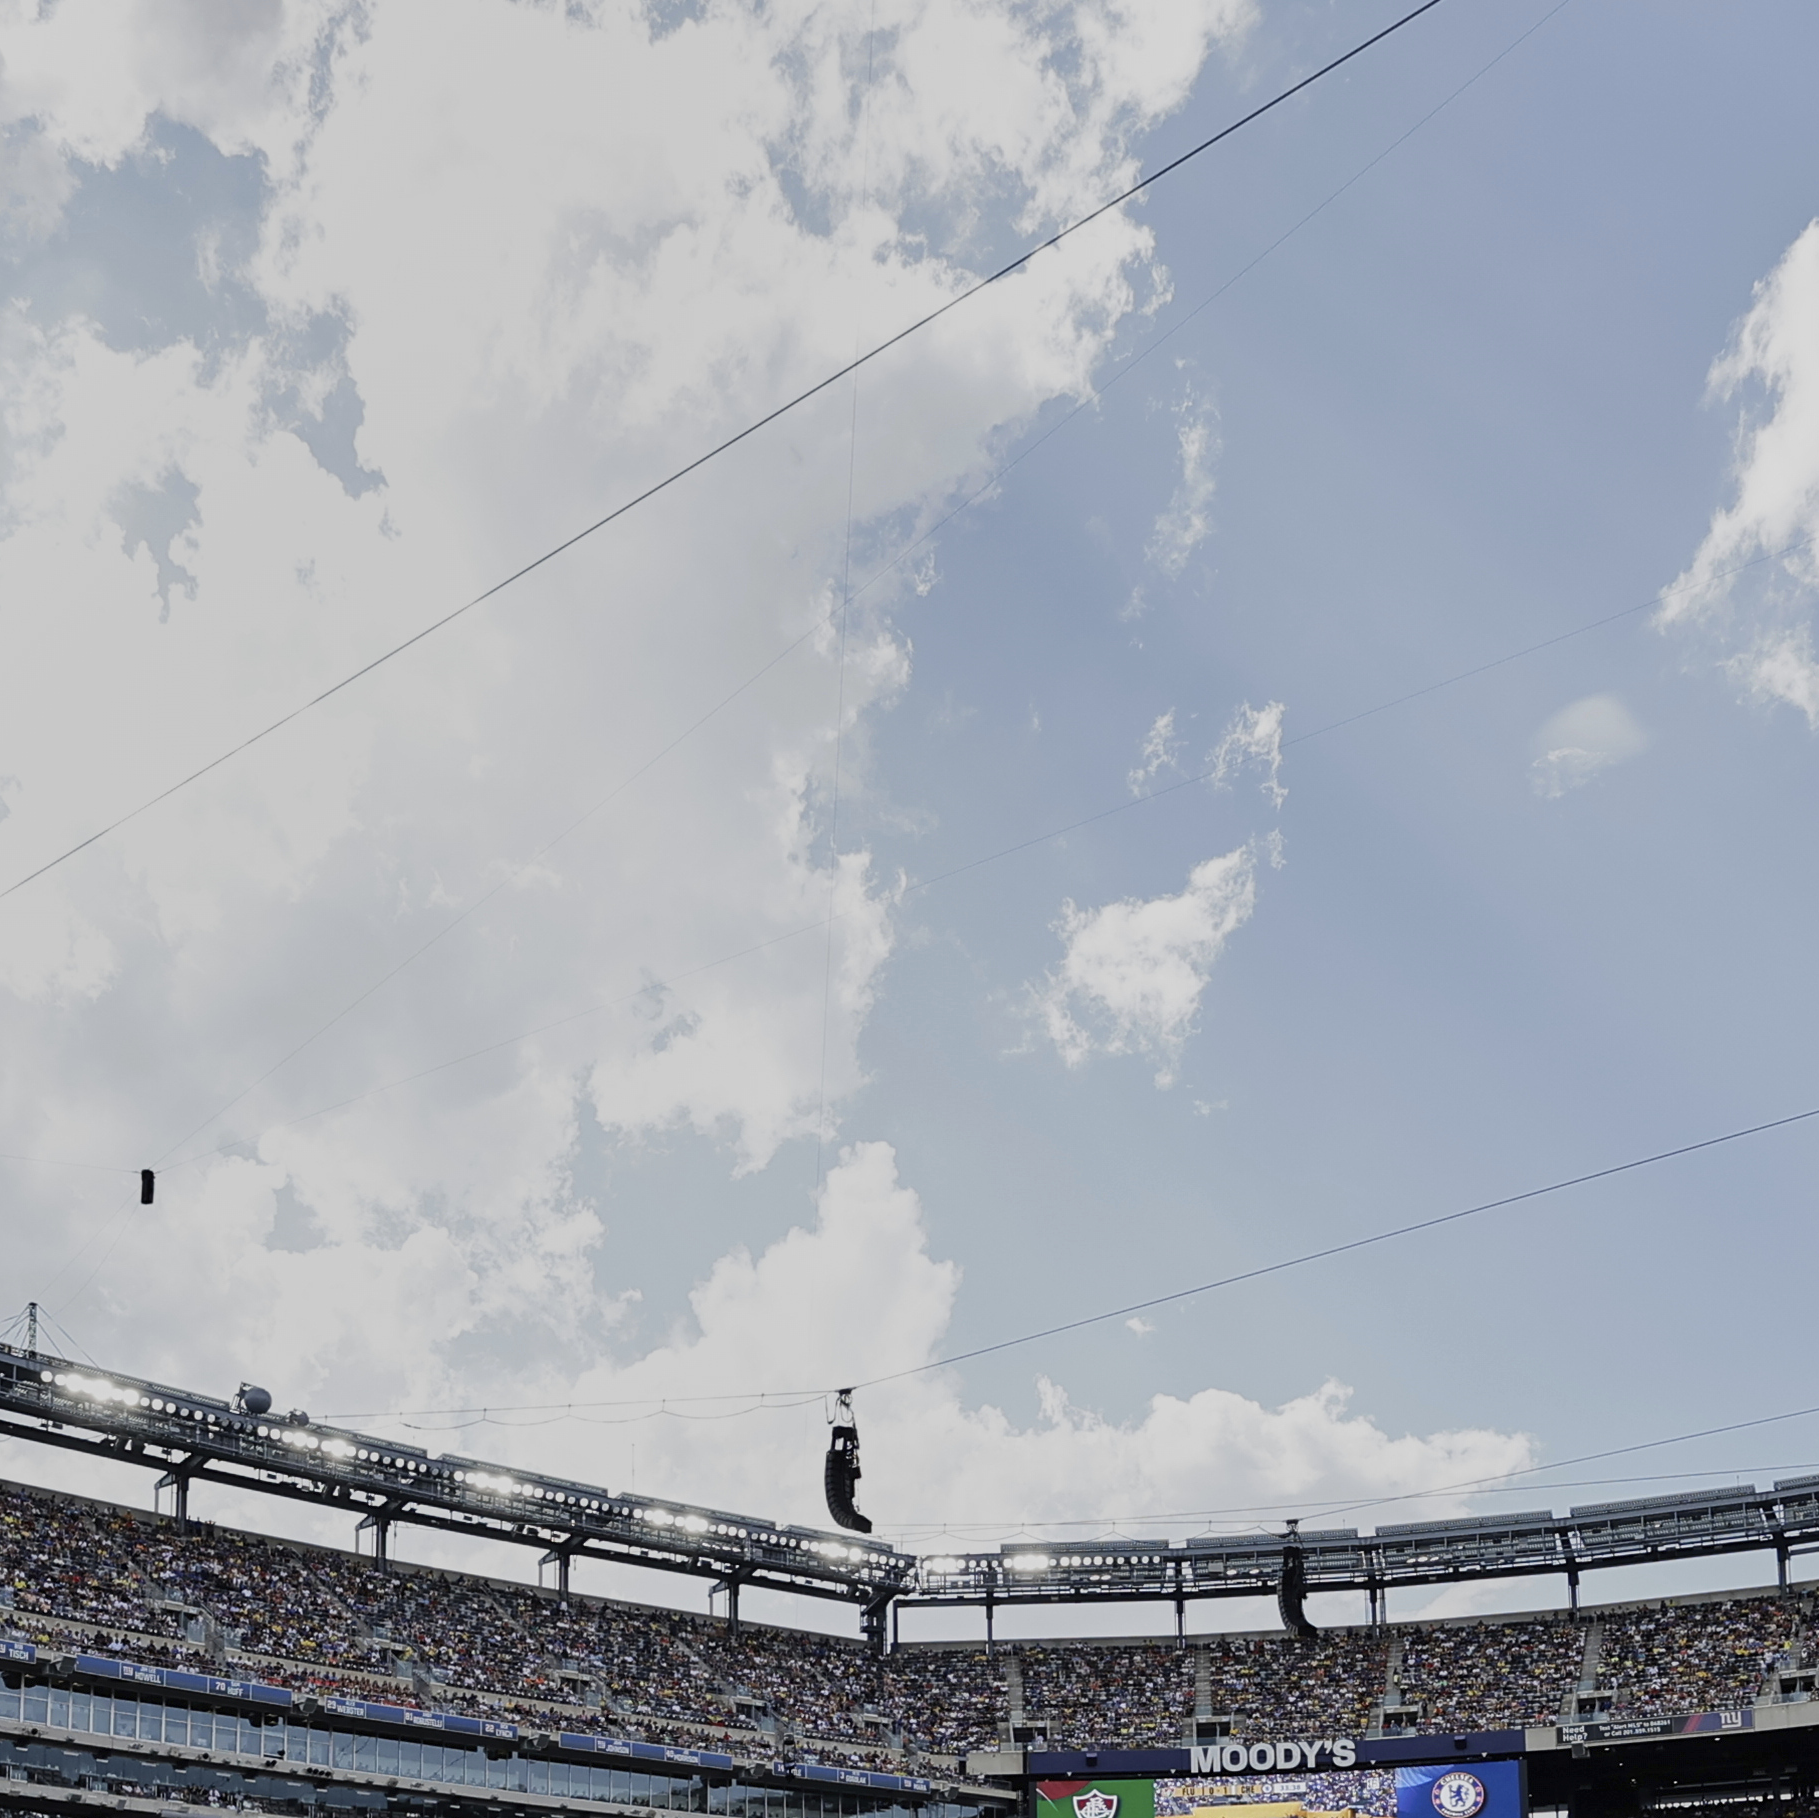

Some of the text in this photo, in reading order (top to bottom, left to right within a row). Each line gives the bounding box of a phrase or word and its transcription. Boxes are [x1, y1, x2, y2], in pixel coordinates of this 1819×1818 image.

[9, 1648, 29, 1660] TISCH
[1562, 1725, 1585, 1733] Need
[1190, 1739, 1356, 1773] MOODY'S
